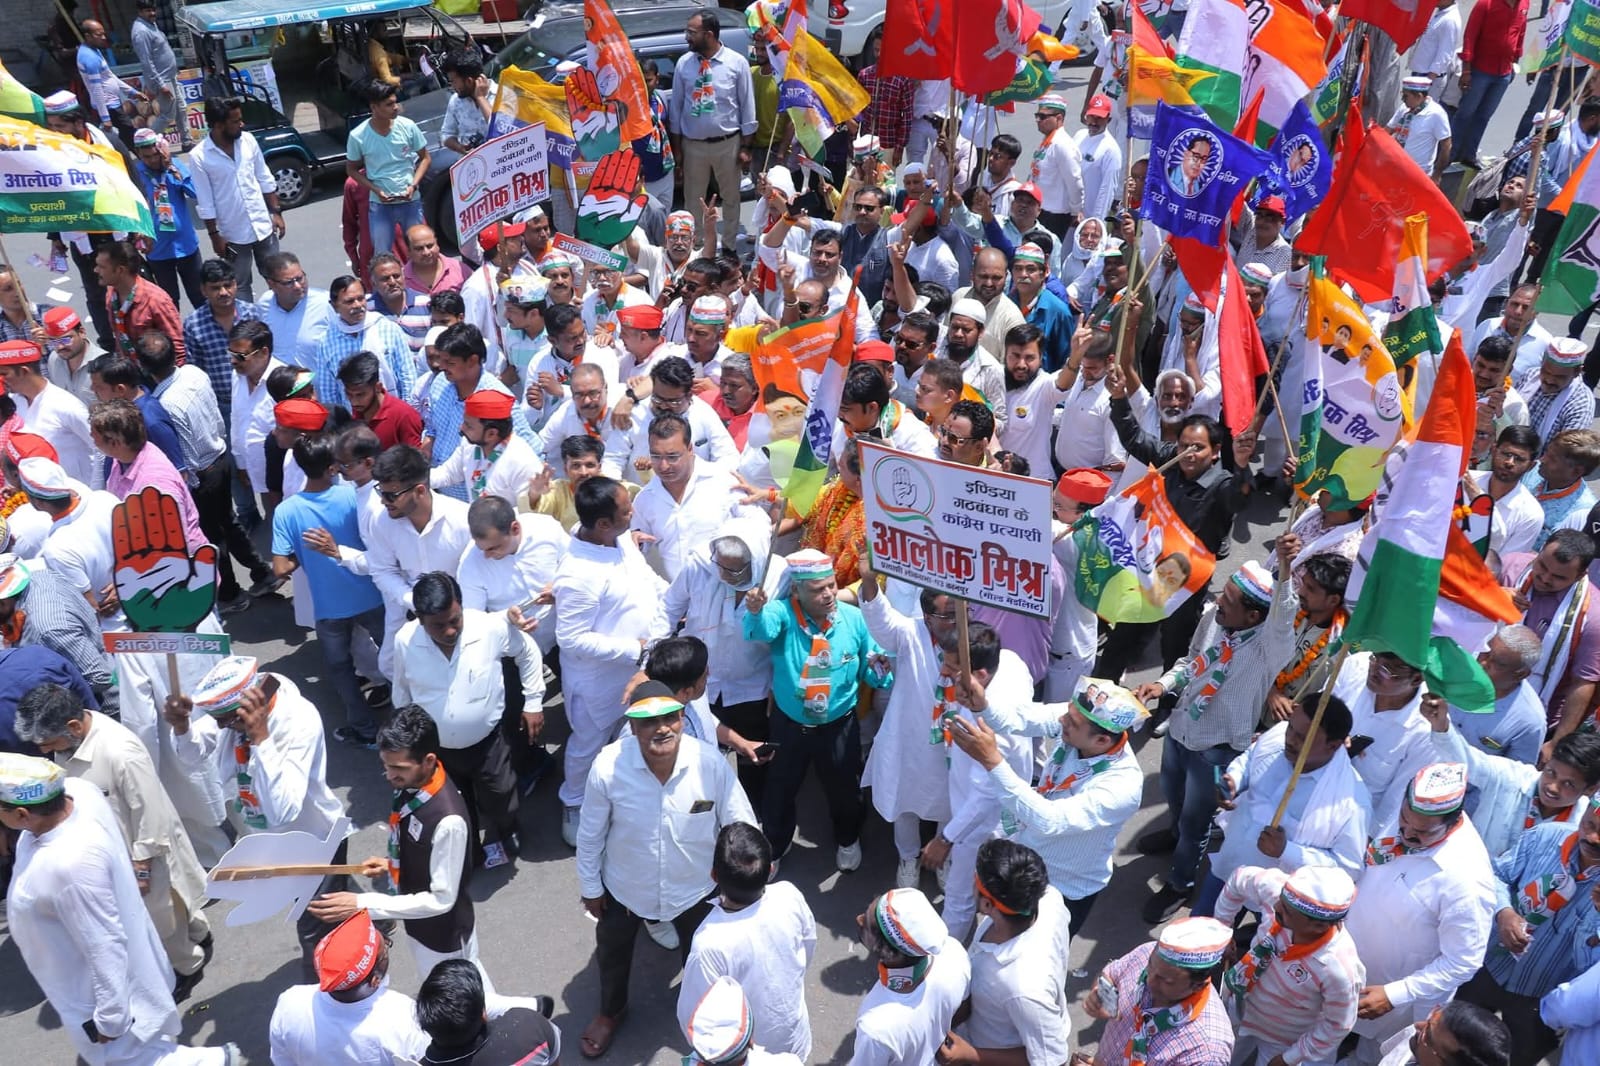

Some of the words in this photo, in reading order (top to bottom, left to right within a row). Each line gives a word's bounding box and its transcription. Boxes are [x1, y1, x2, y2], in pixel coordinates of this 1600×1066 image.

[4, 170, 63, 188] आलोक
[67, 168, 98, 186] मिश्र
[30, 199, 66, 213] प्रत्याशी
[459, 184, 510, 233] आलोक
[512, 170, 546, 202] मिश्र
[80, 211, 91, 221] 43
[559, 240, 595, 258] आलोक
[1344, 413, 1380, 445] मिश्र
[965, 480, 1017, 501] इण्डिया
[953, 496, 1009, 519] गठबंधन
[1014, 508, 1030, 522] के
[942, 511, 984, 531] कांग्रेस
[990, 522, 1042, 543] प्रत्याशी
[872, 521, 977, 583] आलोक
[980, 541, 1048, 603] मिश्र
[114, 636, 178, 651] आलोक
[183, 635, 221, 652] मिश्र
